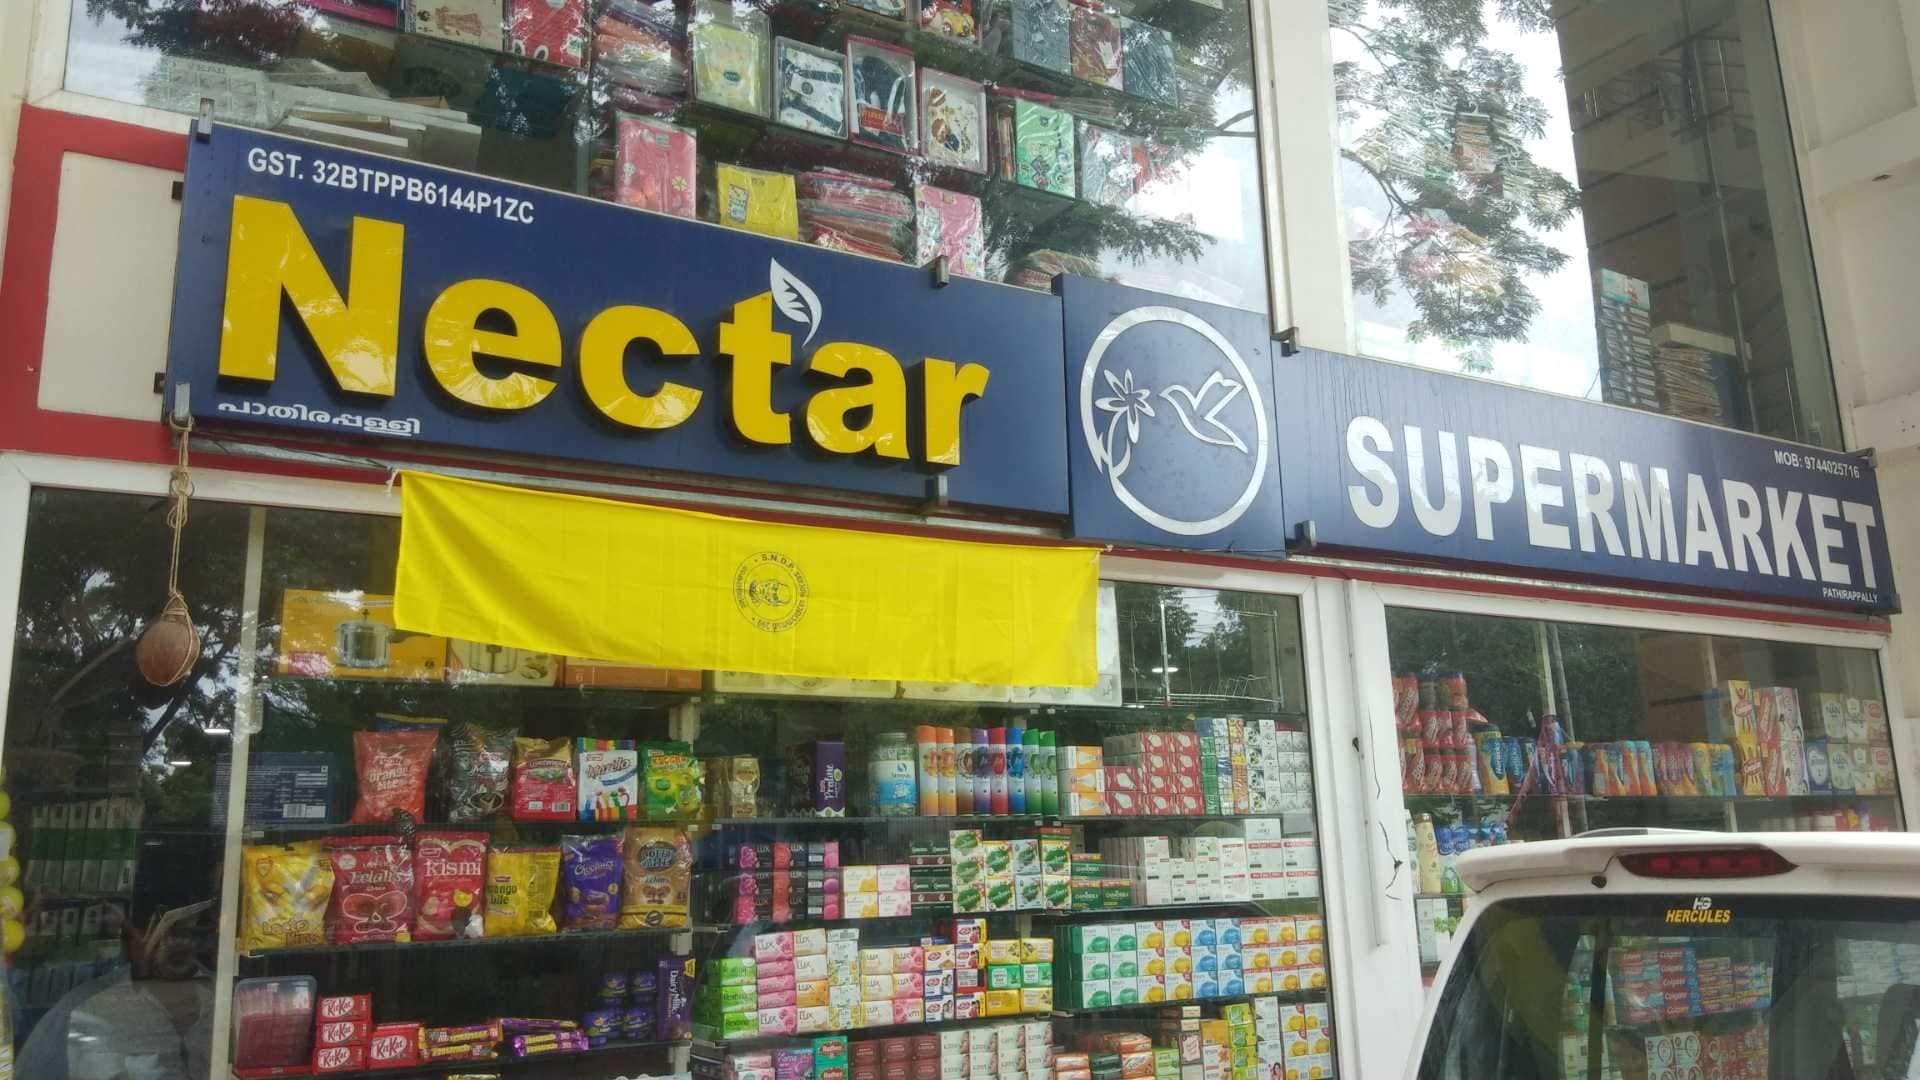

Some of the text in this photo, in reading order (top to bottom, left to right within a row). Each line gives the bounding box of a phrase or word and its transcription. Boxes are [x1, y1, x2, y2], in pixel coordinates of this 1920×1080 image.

[247, 147, 535, 225] GST. 32BTPPB6144P1ZC
[218, 194, 990, 467] Nectar
[218, 401, 421, 437] പാതിരപ്പള്ളി
[1774, 450, 1861, 479] MOB: 9744025716
[1347, 415, 1877, 589] SUPERMARKET
[1822, 587, 1878, 604] PATHIRAPPALLY
[1665, 909, 1732, 923] HERCULES
